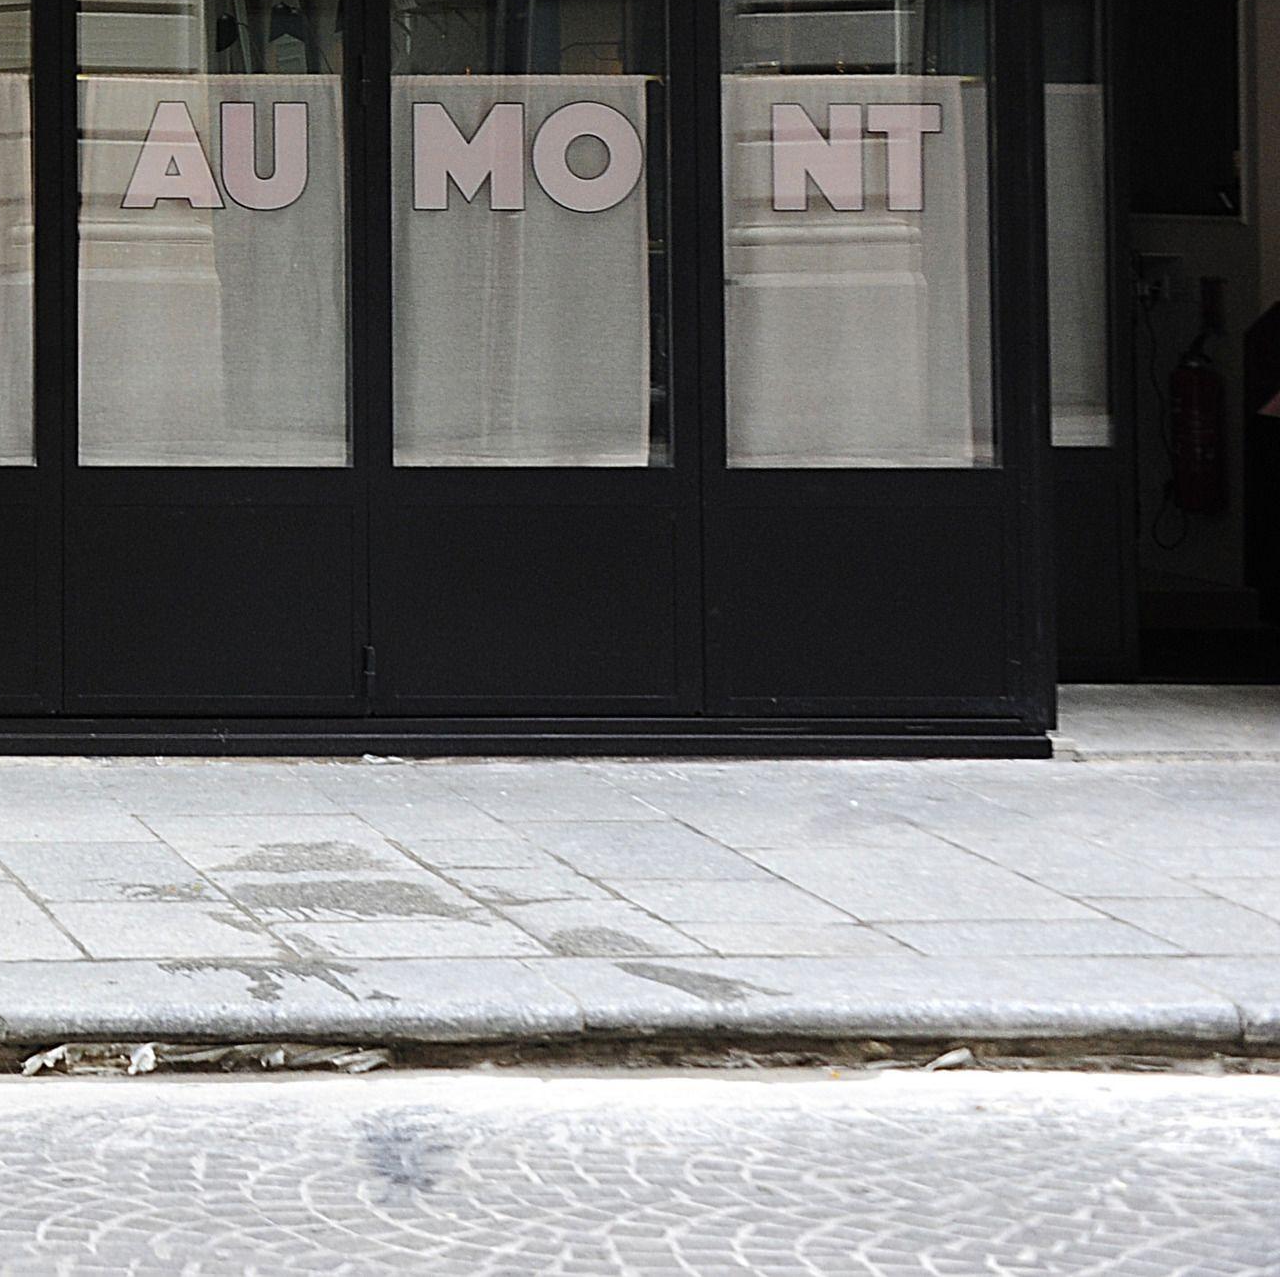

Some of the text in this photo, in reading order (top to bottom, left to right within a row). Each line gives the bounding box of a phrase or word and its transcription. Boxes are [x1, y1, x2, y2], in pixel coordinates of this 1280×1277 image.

[120, 101, 310, 211] AU
[412, 100, 643, 213] MO
[771, 102, 943, 212] NT
